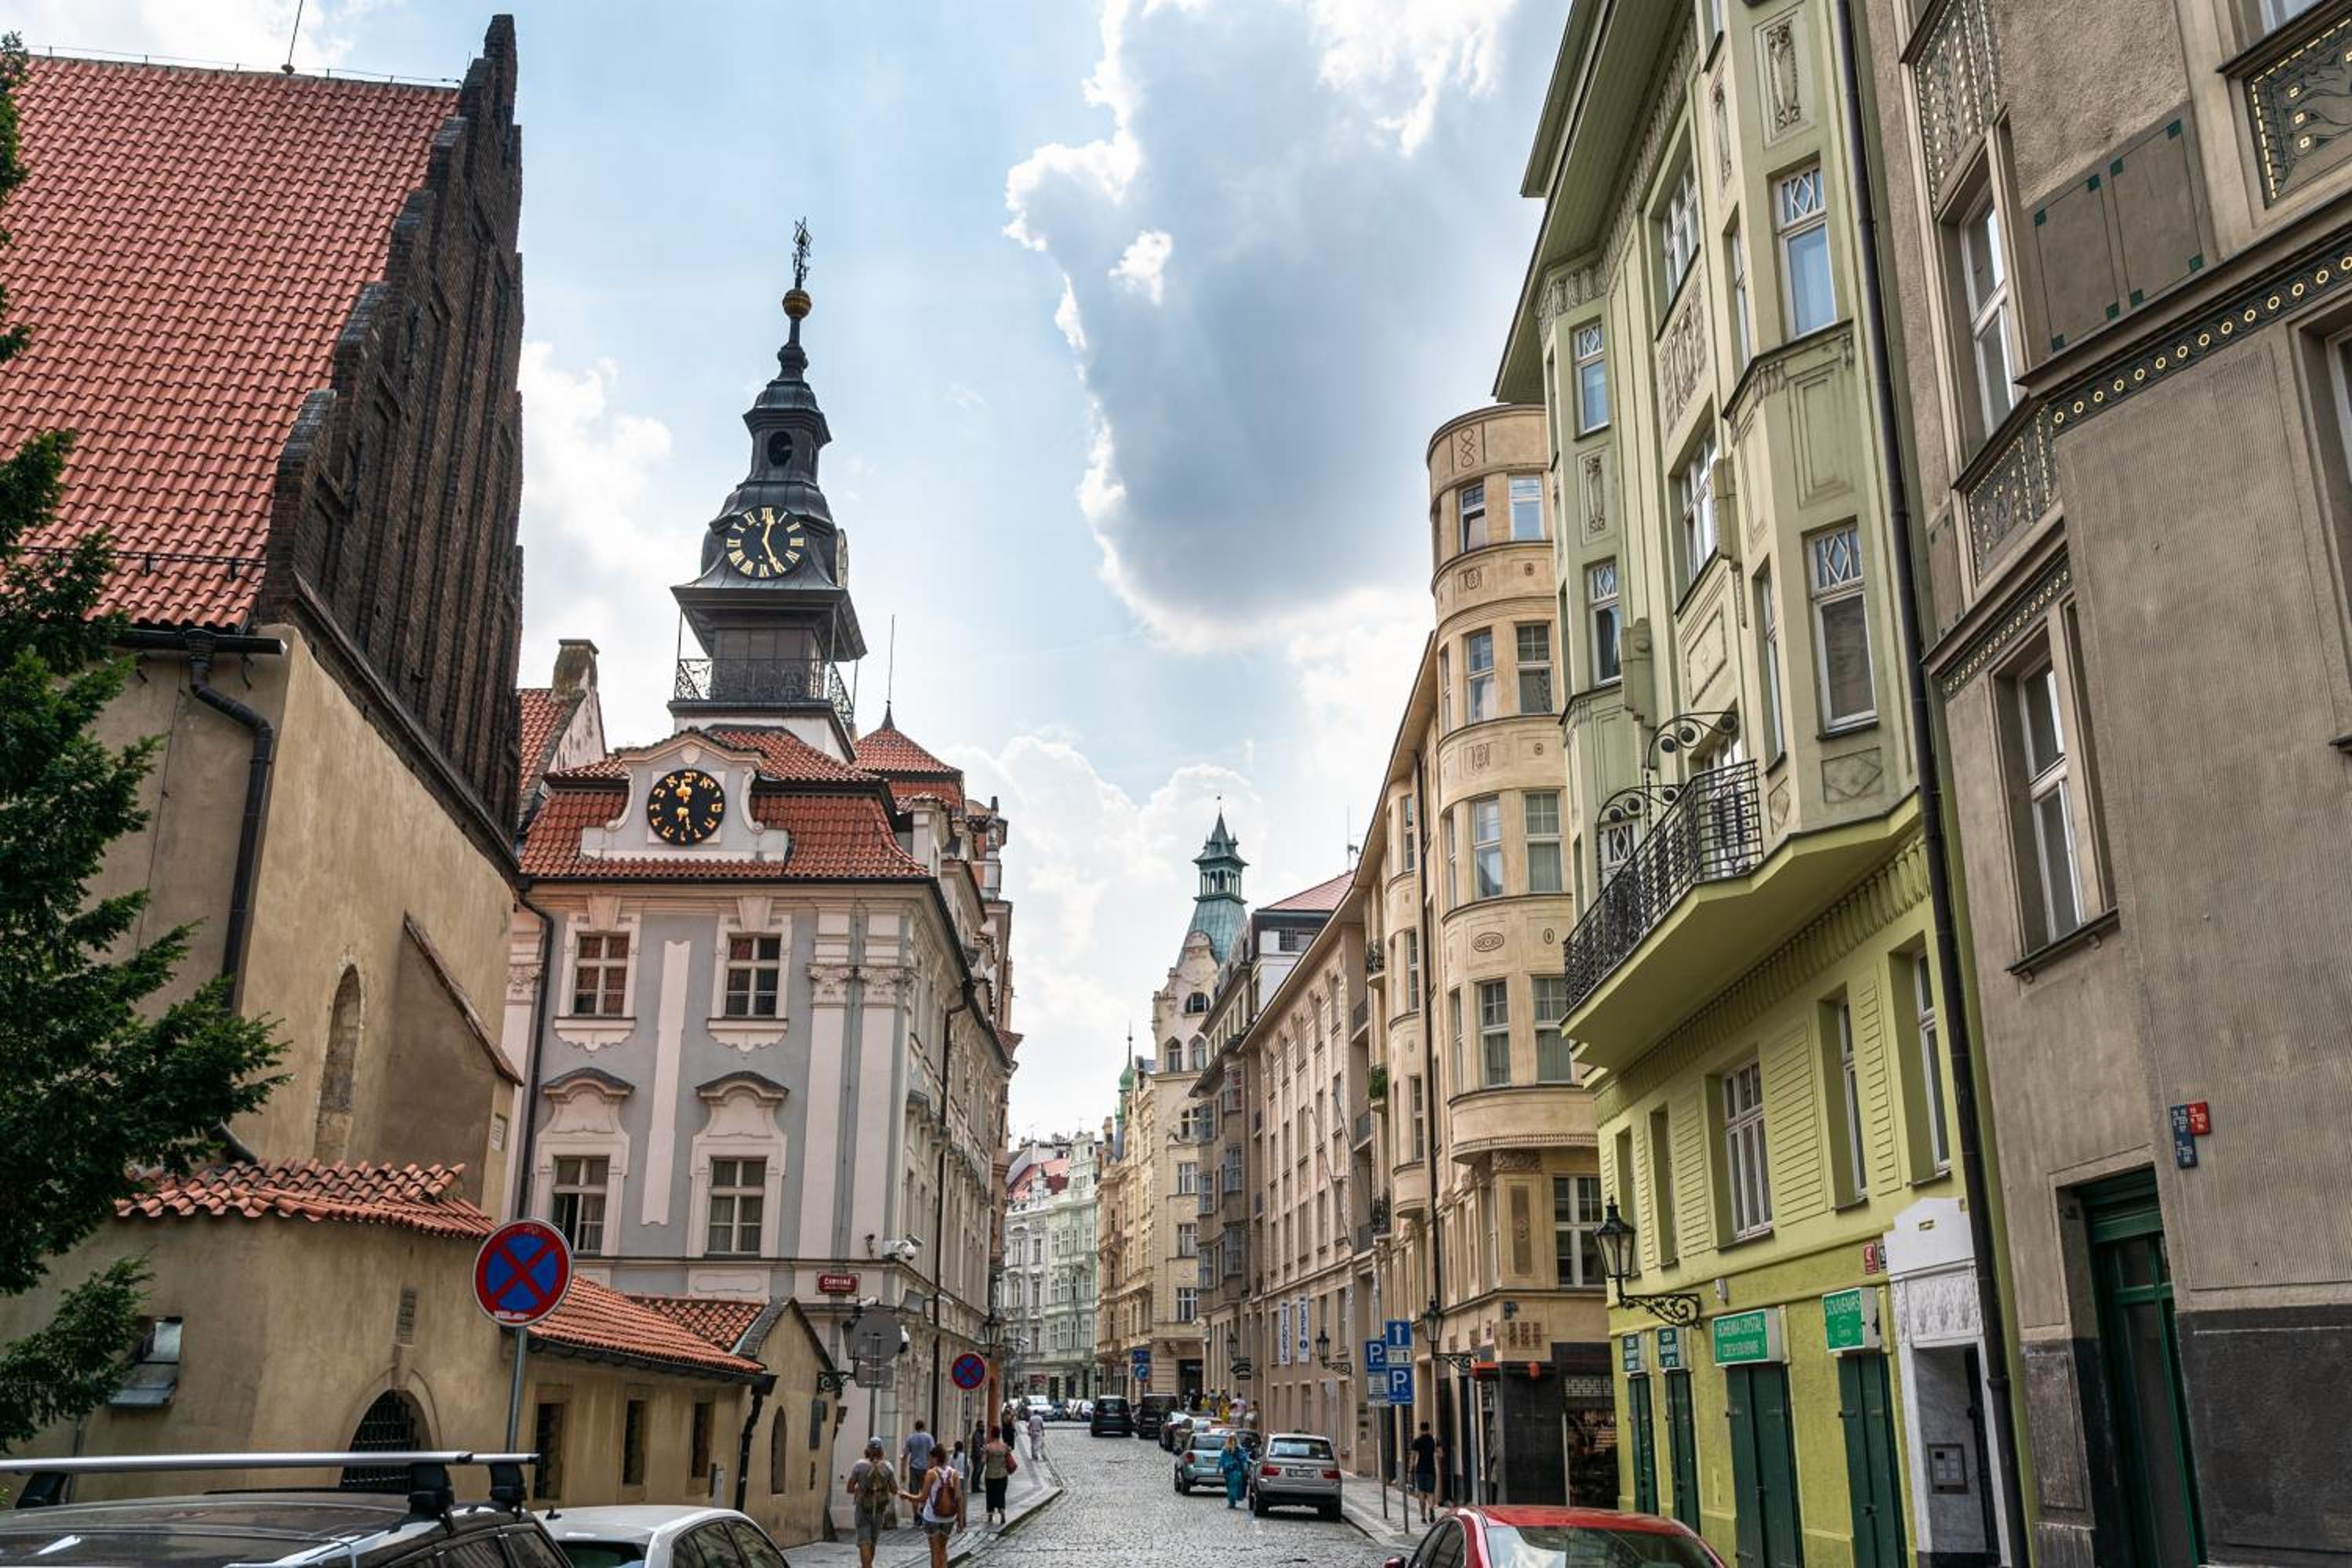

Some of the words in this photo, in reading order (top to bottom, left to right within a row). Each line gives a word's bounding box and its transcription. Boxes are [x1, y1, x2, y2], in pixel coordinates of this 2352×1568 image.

[778, 511, 788, 524] I
[1369, 1343, 1383, 1363] P
[1392, 1370, 1407, 1393] P
